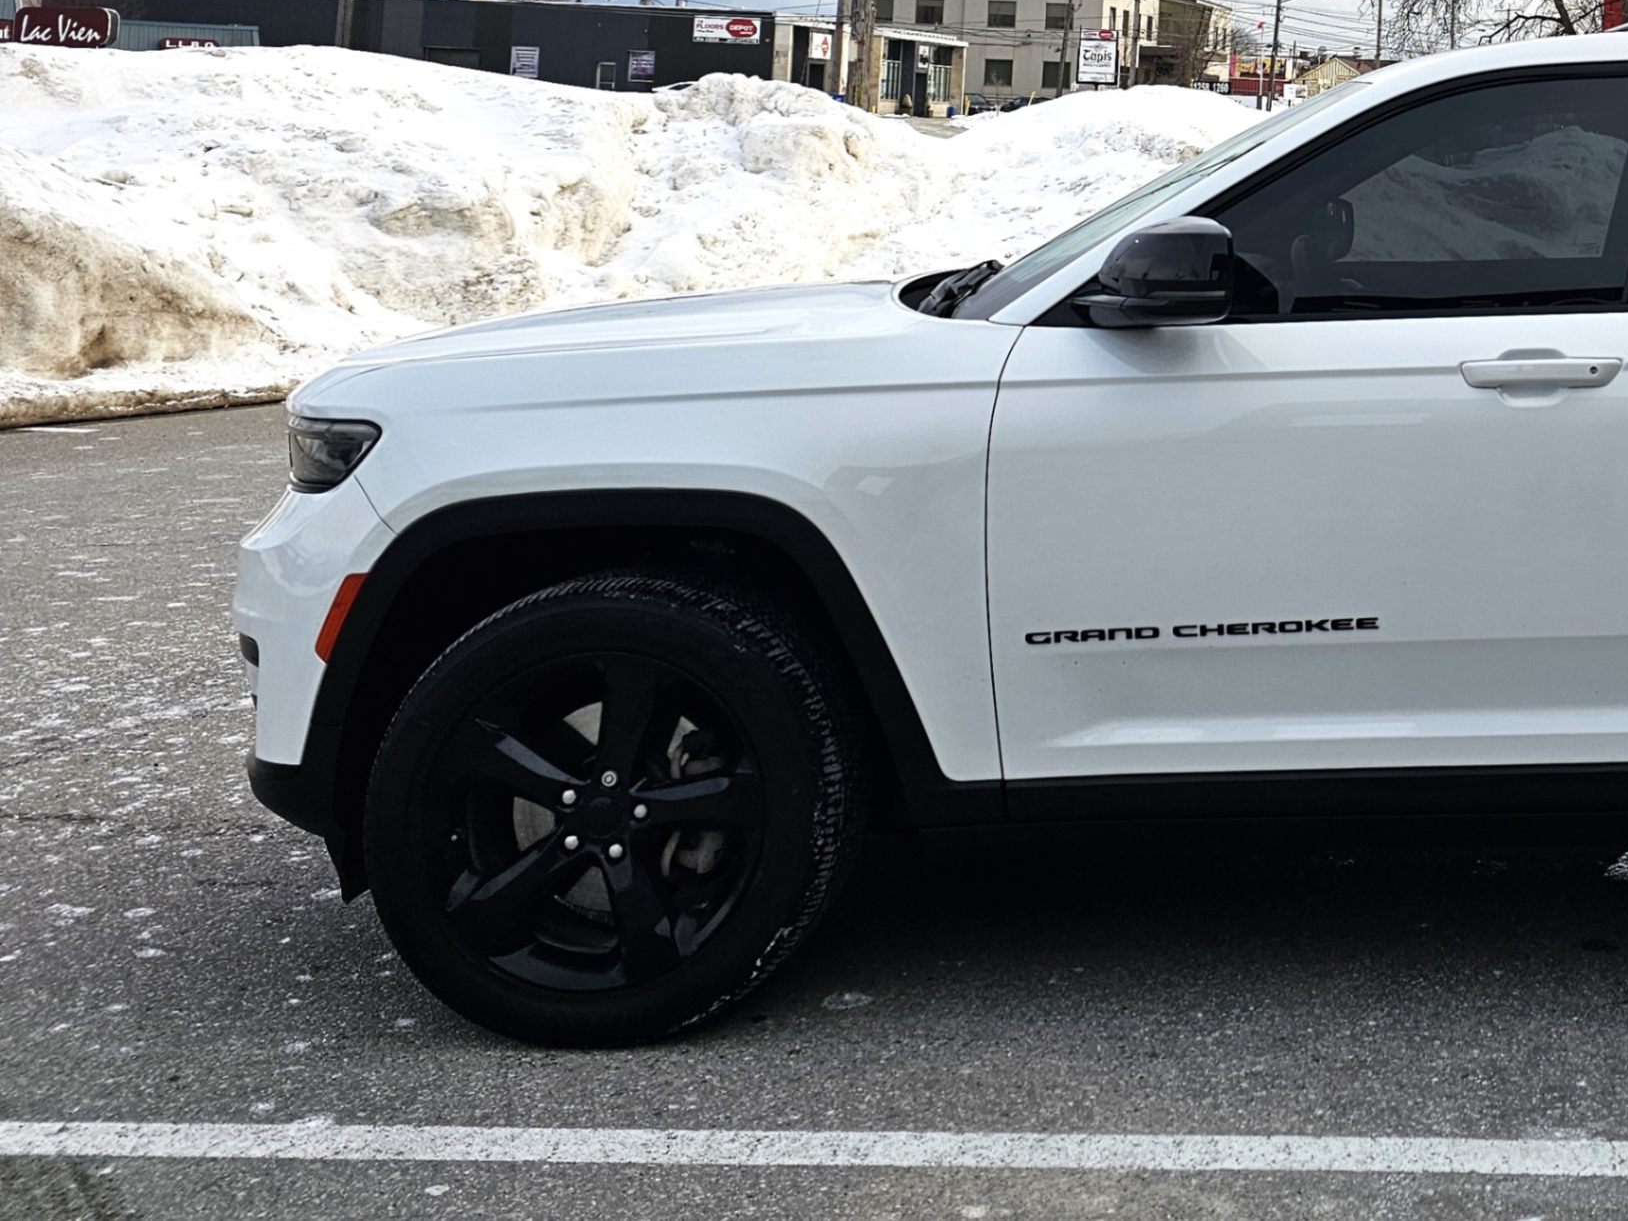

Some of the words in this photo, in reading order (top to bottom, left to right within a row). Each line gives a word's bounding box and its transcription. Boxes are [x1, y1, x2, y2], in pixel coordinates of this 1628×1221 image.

[20, 14, 52, 42] Lac
[58, 14, 101, 43] Vien
[1083, 49, 1112, 63] Tapis
[1212, 83, 1229, 93] 1260
[1025, 626, 1160, 645] GRAND
[1172, 617, 1379, 638] CHEROKEE
